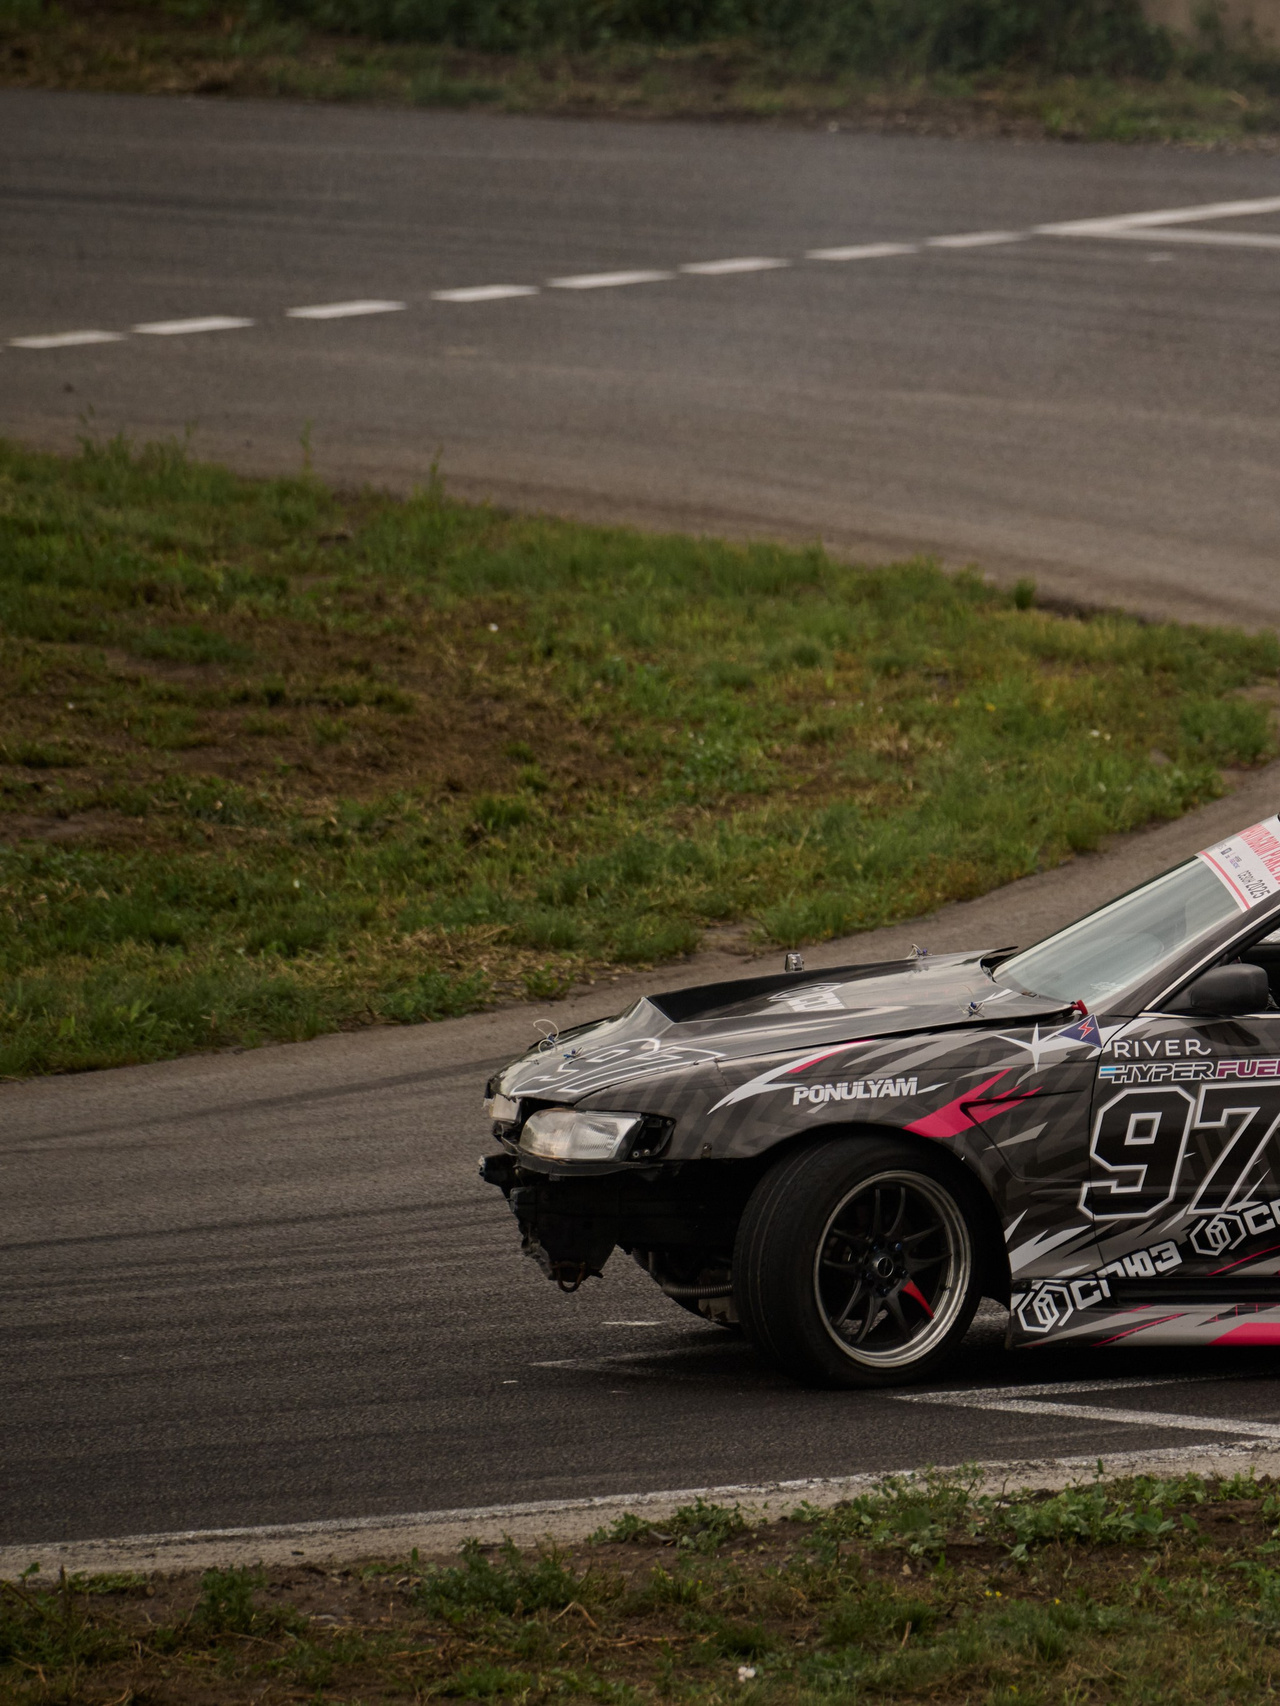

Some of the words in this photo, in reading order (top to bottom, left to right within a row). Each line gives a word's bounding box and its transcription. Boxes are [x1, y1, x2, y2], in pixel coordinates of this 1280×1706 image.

[1245, 879, 1270, 899] 2025
[1114, 1039, 1212, 1058] RIVER
[792, 1077, 918, 1106] PONULYAM
